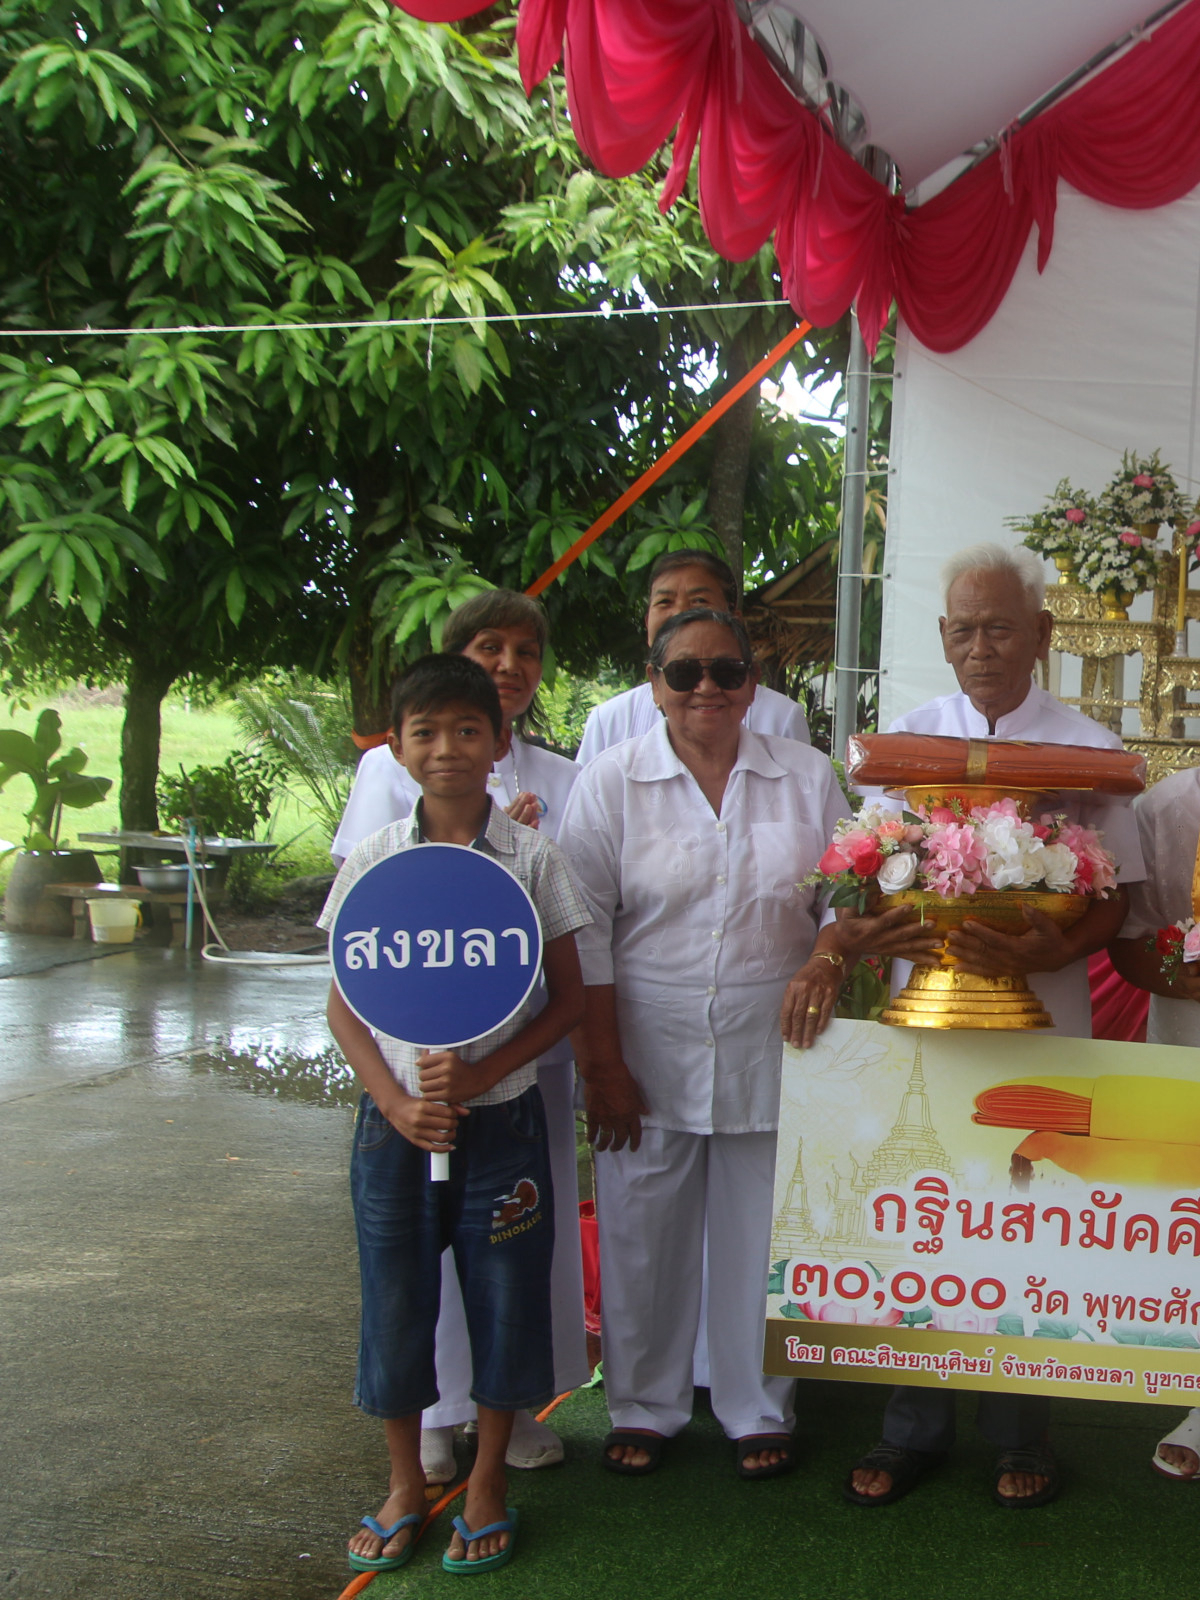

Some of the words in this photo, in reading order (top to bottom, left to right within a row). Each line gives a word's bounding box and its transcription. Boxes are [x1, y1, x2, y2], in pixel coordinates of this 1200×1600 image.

[343, 926, 529, 970] สงขลา
[792, 1262, 1007, 1310] ๓๐,๐๐๐
[1024, 1275, 1069, 1315] วัด
[787, 1337, 824, 1361] โดย
[832, 1345, 994, 1378] คณะศิษยานุศิษย์
[1001, 1355, 1134, 1385] จังหวัดสงขลา
